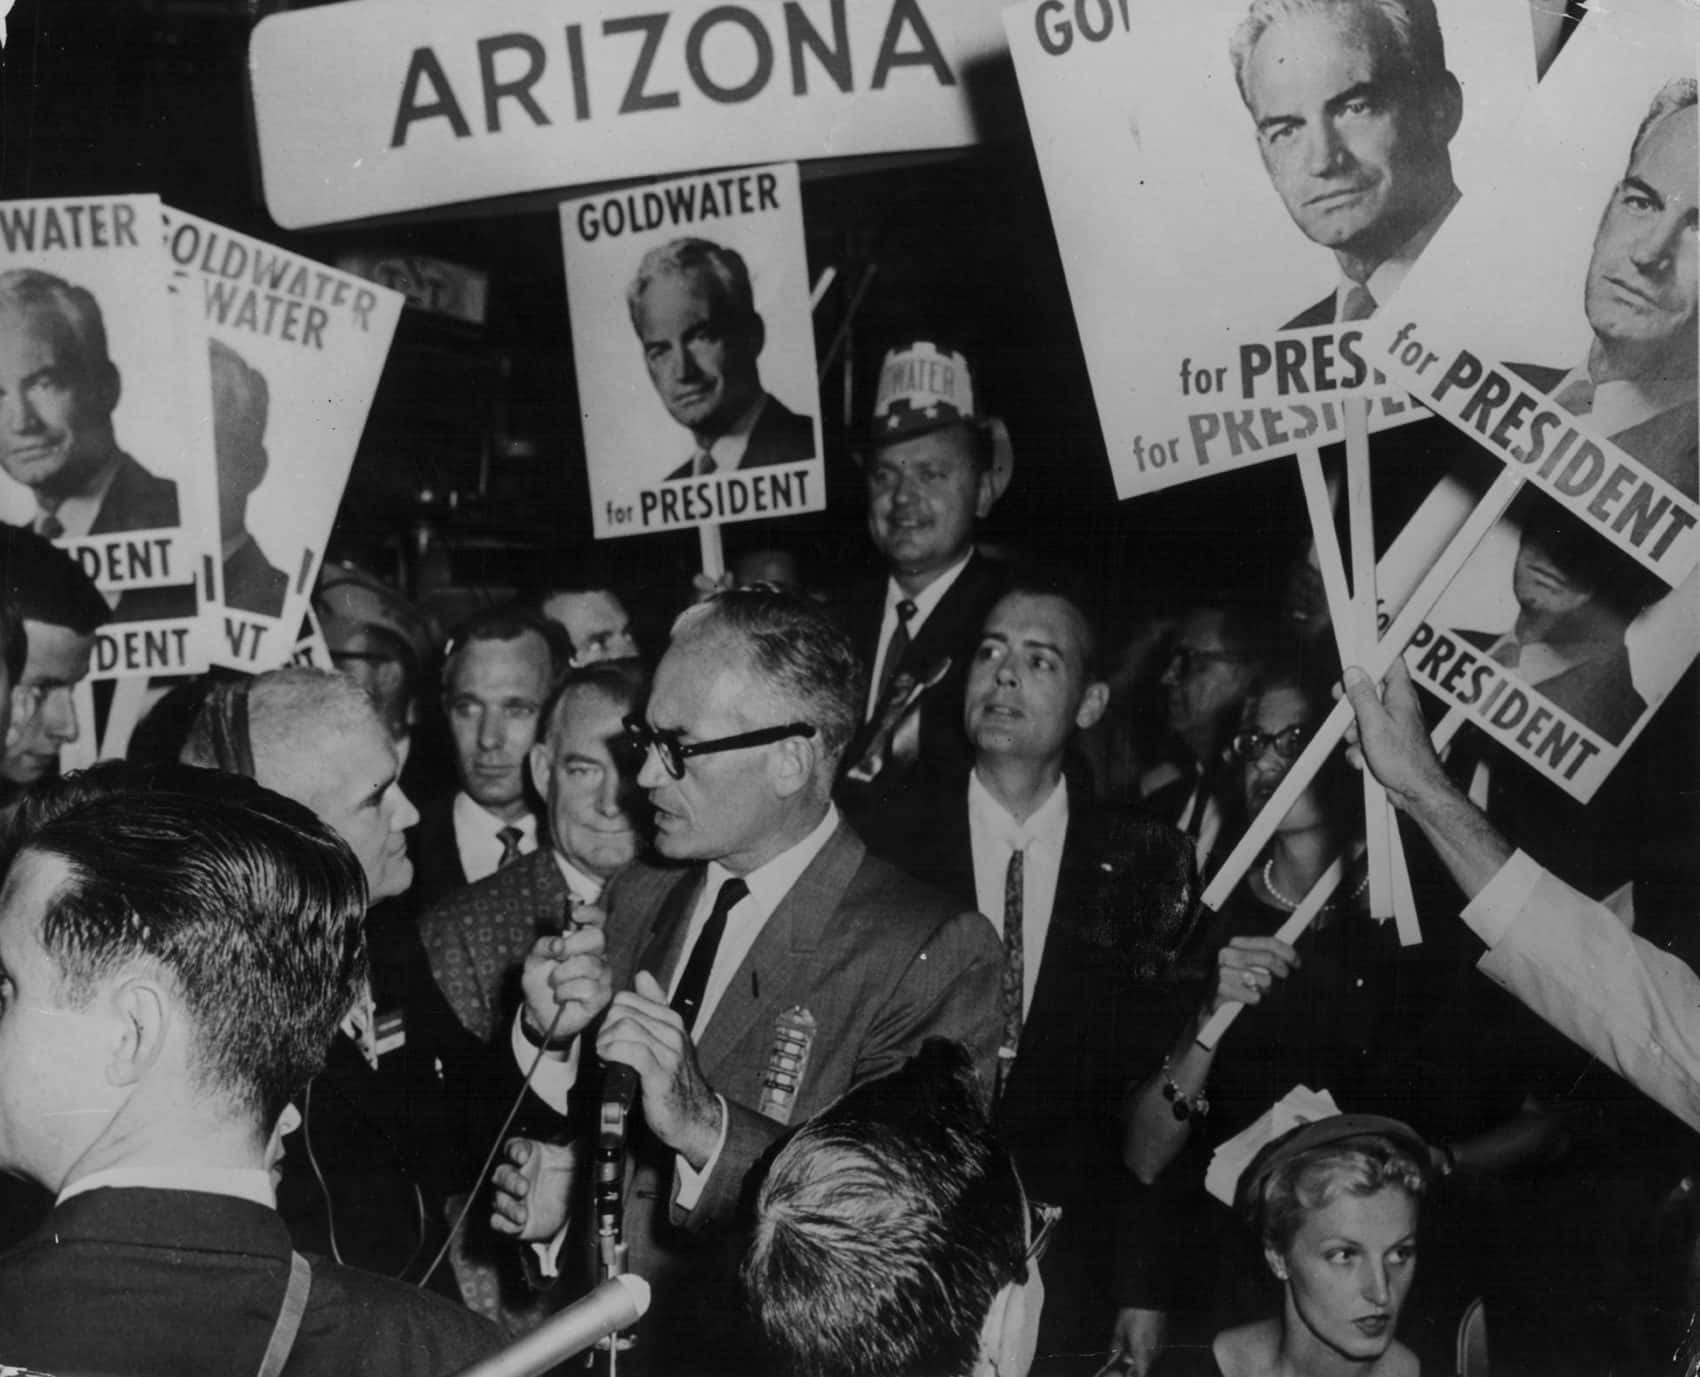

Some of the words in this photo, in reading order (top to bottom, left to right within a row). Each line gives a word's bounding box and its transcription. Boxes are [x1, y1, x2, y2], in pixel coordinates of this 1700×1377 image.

[391, 0, 958, 148] ARIZONA
[577, 172, 780, 242] GOLDWATER
[161, 213, 378, 333] OLDWATER
[1178, 357, 1228, 397] for
[1239, 330, 1387, 400] PRES
[1132, 434, 1180, 473] for
[1387, 322, 1440, 376] for
[1430, 348, 1699, 563] PRESIDENT
[606, 500, 634, 526] for
[641, 470, 810, 527] PRESIDENT
[1408, 620, 1601, 782] PRESIDENT
